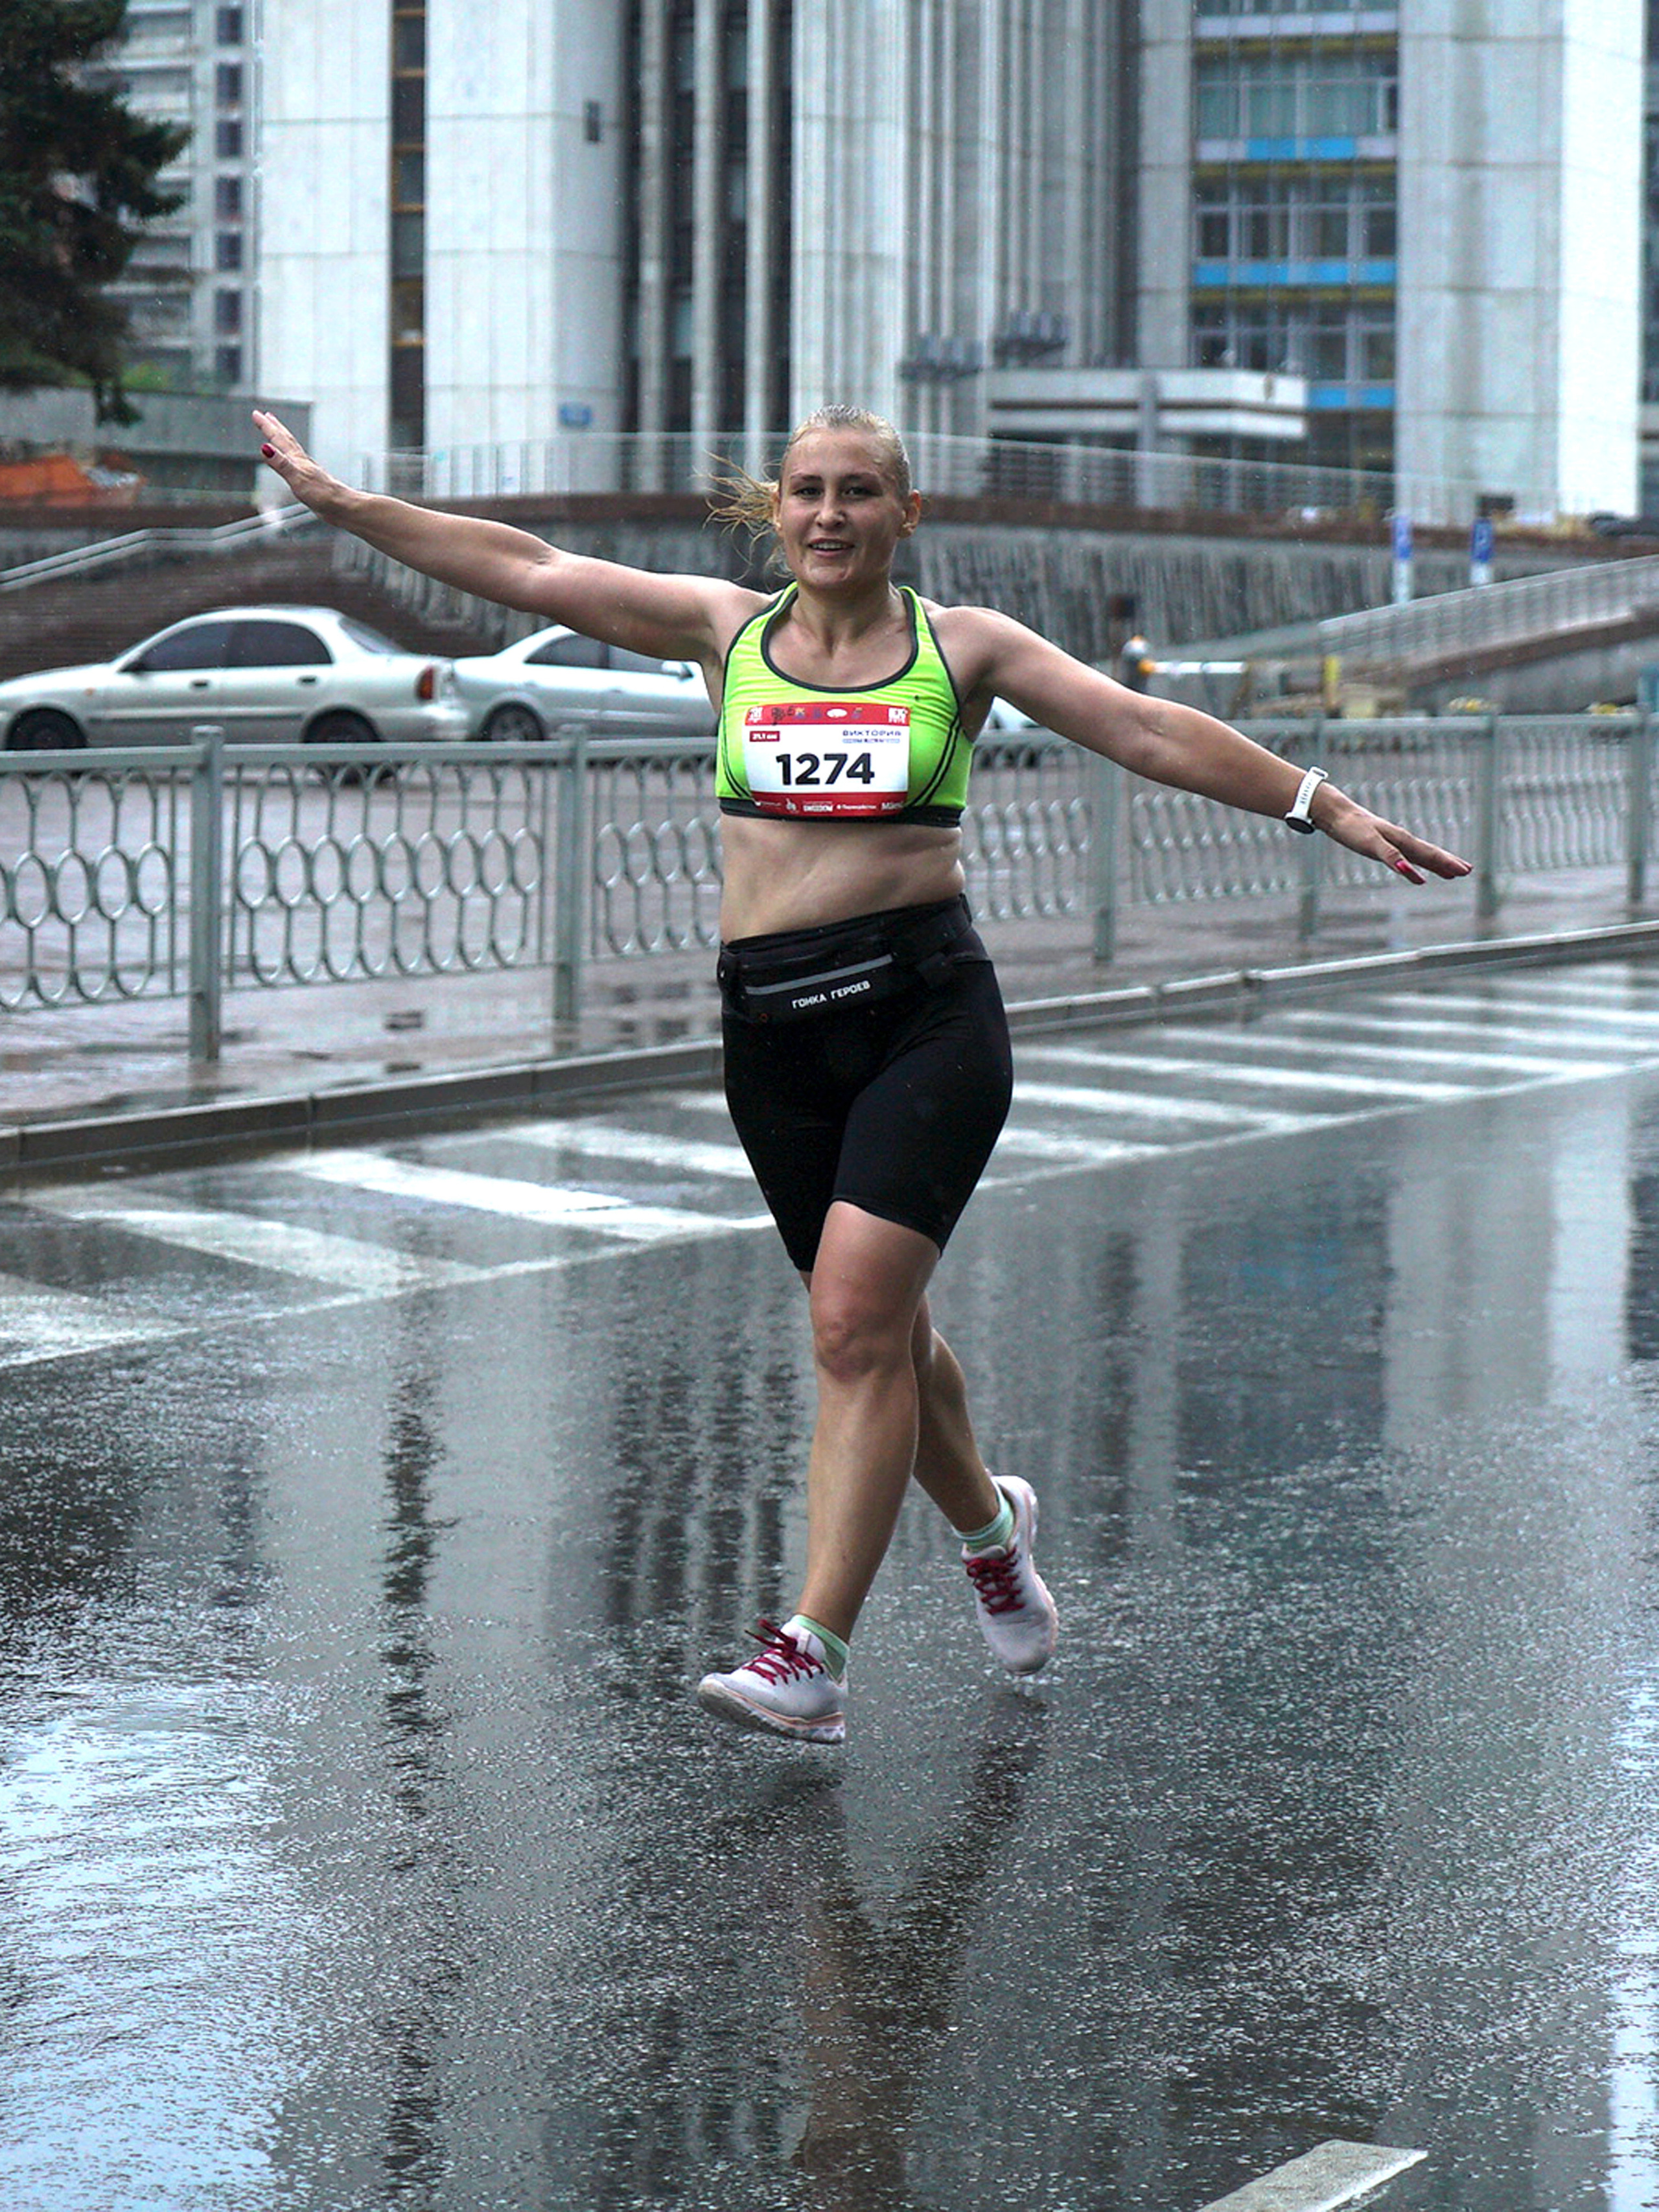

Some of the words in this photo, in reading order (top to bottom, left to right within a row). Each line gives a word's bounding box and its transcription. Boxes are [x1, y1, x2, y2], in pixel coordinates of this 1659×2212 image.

[776, 752, 875, 786] 1274
[792, 994, 827, 1009] ГОНКА
[831, 981, 870, 999] ГЕРОЕВ
